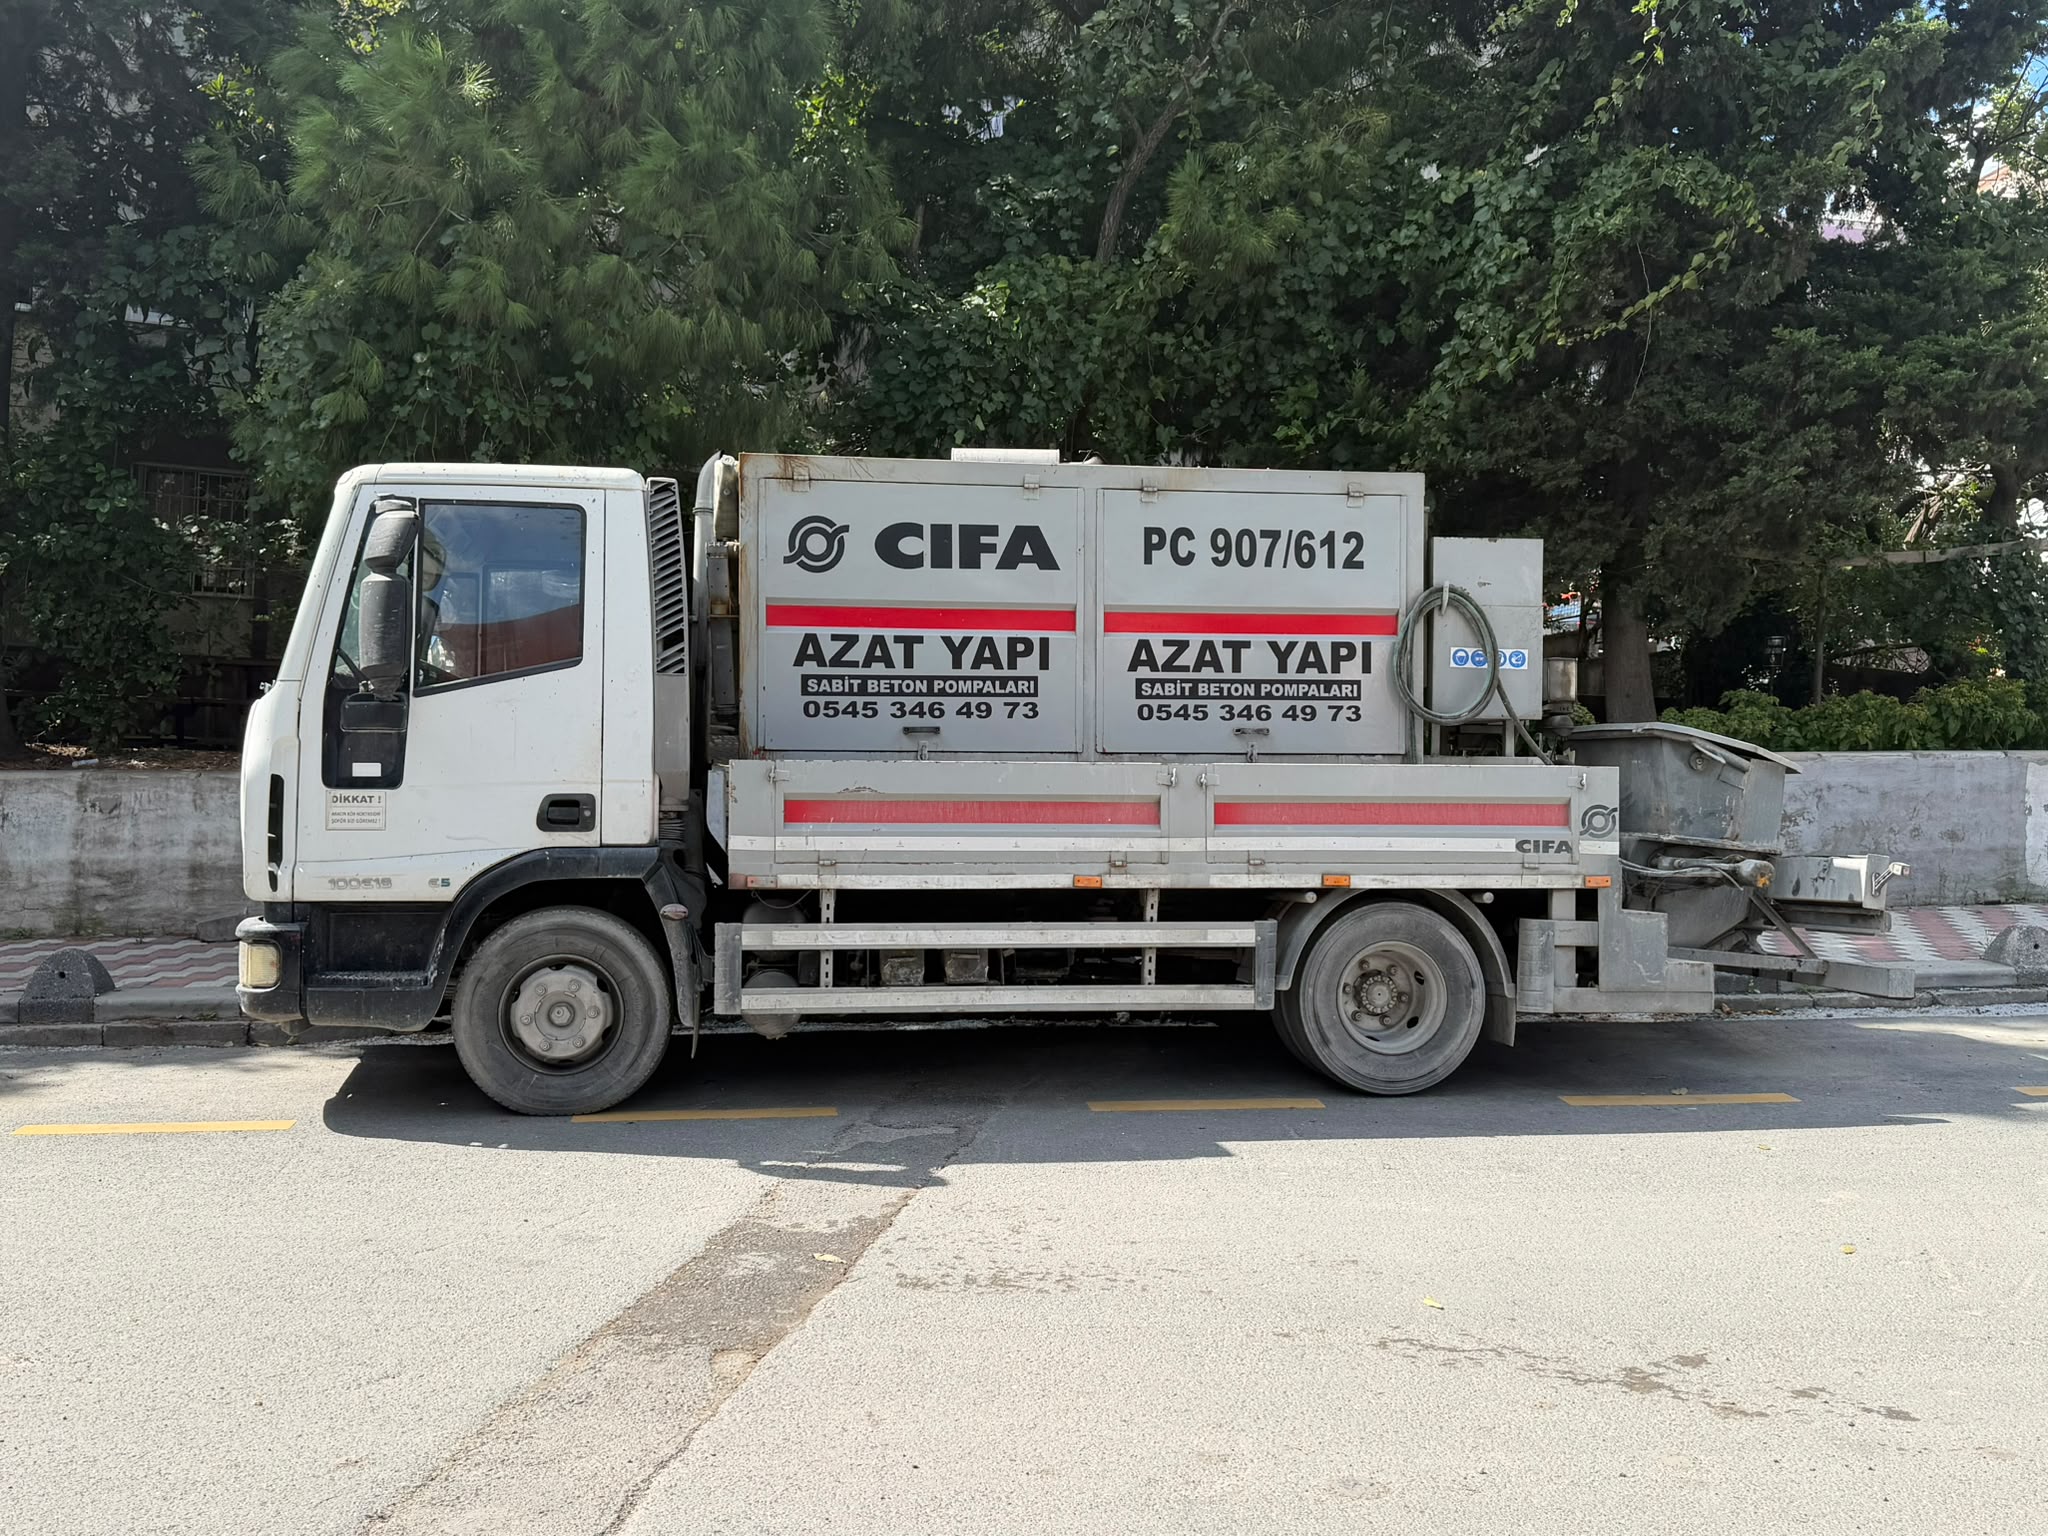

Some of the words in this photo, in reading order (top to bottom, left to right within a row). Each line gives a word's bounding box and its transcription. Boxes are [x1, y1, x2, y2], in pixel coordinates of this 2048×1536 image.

[874, 522, 1061, 571] CIFA
[1143, 526, 1196, 567] PC
[1210, 528, 1365, 570] 907/612
[792, 633, 925, 669] AZAT
[940, 635, 1050, 671] YAPI
[1127, 639, 1252, 674] AZAT
[1267, 641, 1372, 675] YAPI
[806, 676, 862, 693] SABİT
[867, 679, 928, 694] BETON
[933, 680, 1035, 694] POMPALARI
[1141, 680, 1193, 696] SABİT
[1197, 683, 1255, 697] BETON
[1260, 684, 1358, 698] POMPALARI
[803, 701, 879, 719] 0545
[890, 701, 946, 719] 346
[955, 702, 993, 720] 49
[1003, 702, 1039, 720] 73
[1137, 704, 1209, 722] 0545
[1219, 705, 1272, 722] 346
[1281, 705, 1318, 722] 49
[1327, 705, 1362, 723] 73
[332, 793, 375, 804] DİKKAT
[1515, 839, 1573, 854] CIFA
